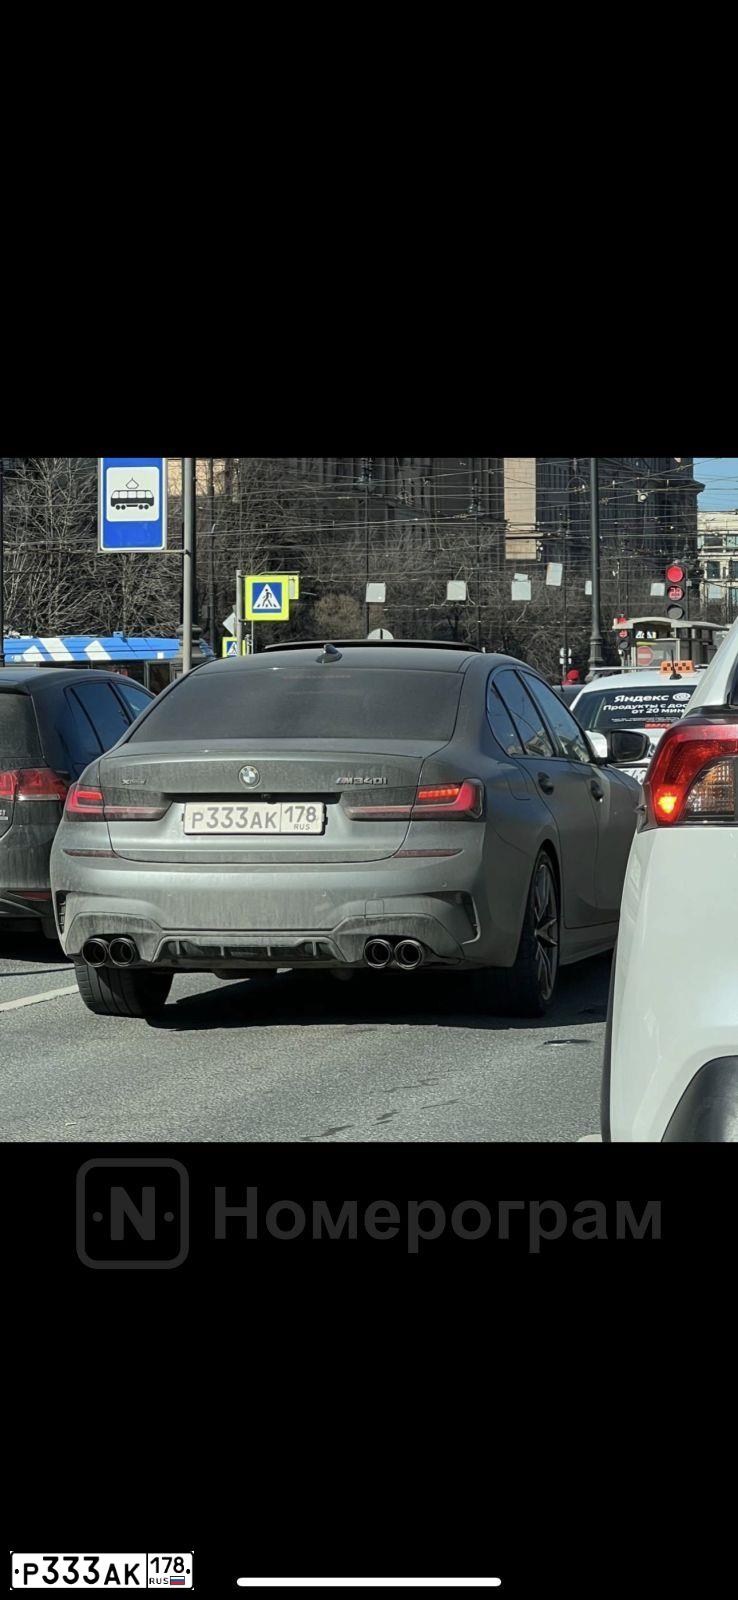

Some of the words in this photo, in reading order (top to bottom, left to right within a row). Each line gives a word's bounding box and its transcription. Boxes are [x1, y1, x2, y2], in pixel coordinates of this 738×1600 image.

[614, 694, 669, 703] Яндекс
[603, 703, 658, 711] Продукты
[191, 806, 278, 829] Р333АК
[284, 805, 317, 823] 178
[293, 823, 311, 831] RUS
